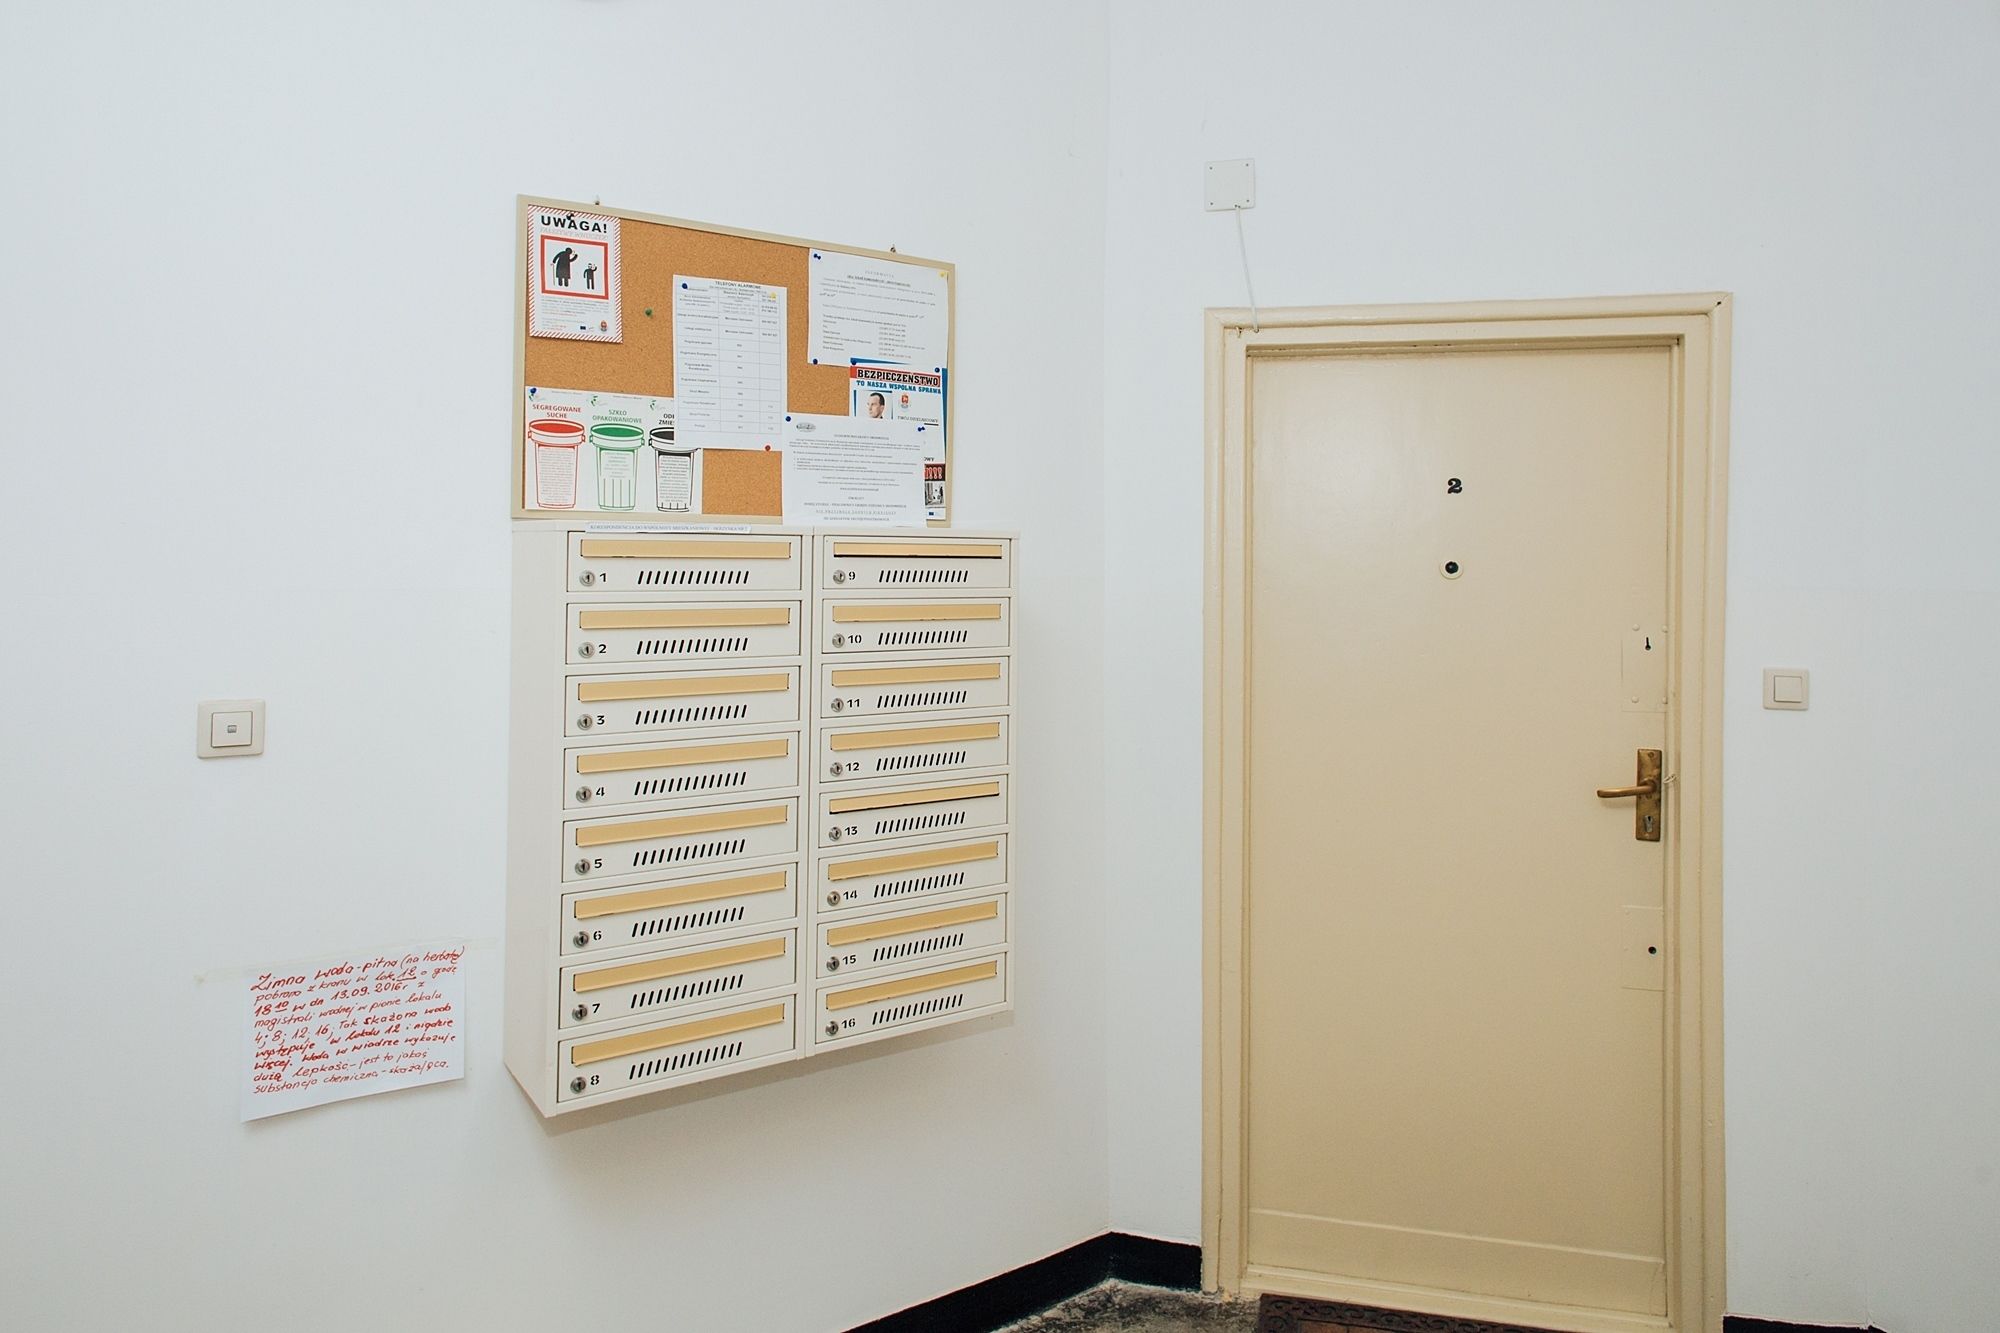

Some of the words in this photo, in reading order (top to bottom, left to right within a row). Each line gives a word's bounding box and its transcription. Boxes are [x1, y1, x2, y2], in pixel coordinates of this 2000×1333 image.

[541, 215, 607, 234] UWAGA!
[918, 386, 941, 394] SPRAWA
[532, 403, 581, 413] SEGREGOWANE
[592, 415, 642, 423] OPAKOWANIOWE
[1447, 478, 1462, 495] 2
[599, 572, 607, 583] 1
[848, 571, 856, 581] 9
[847, 634, 862, 644] 10
[598, 643, 607, 654] 2
[846, 698, 860, 708] 11
[596, 714, 605, 726] 3
[845, 761, 860, 772] 12
[595, 786, 606, 797] 4
[844, 825, 858, 836] 13
[594, 858, 603, 869] 5
[842, 889, 858, 901] 14
[592, 930, 602, 941] 6
[842, 954, 857, 966] 15
[292, 1003, 306, 1012] w
[591, 1002, 601, 1014] 7
[841, 1018, 856, 1029] 16
[330, 1037, 341, 1045] w
[336, 1048, 348, 1056] w
[383, 1052, 394, 1061] to
[590, 1074, 600, 1086] 8
